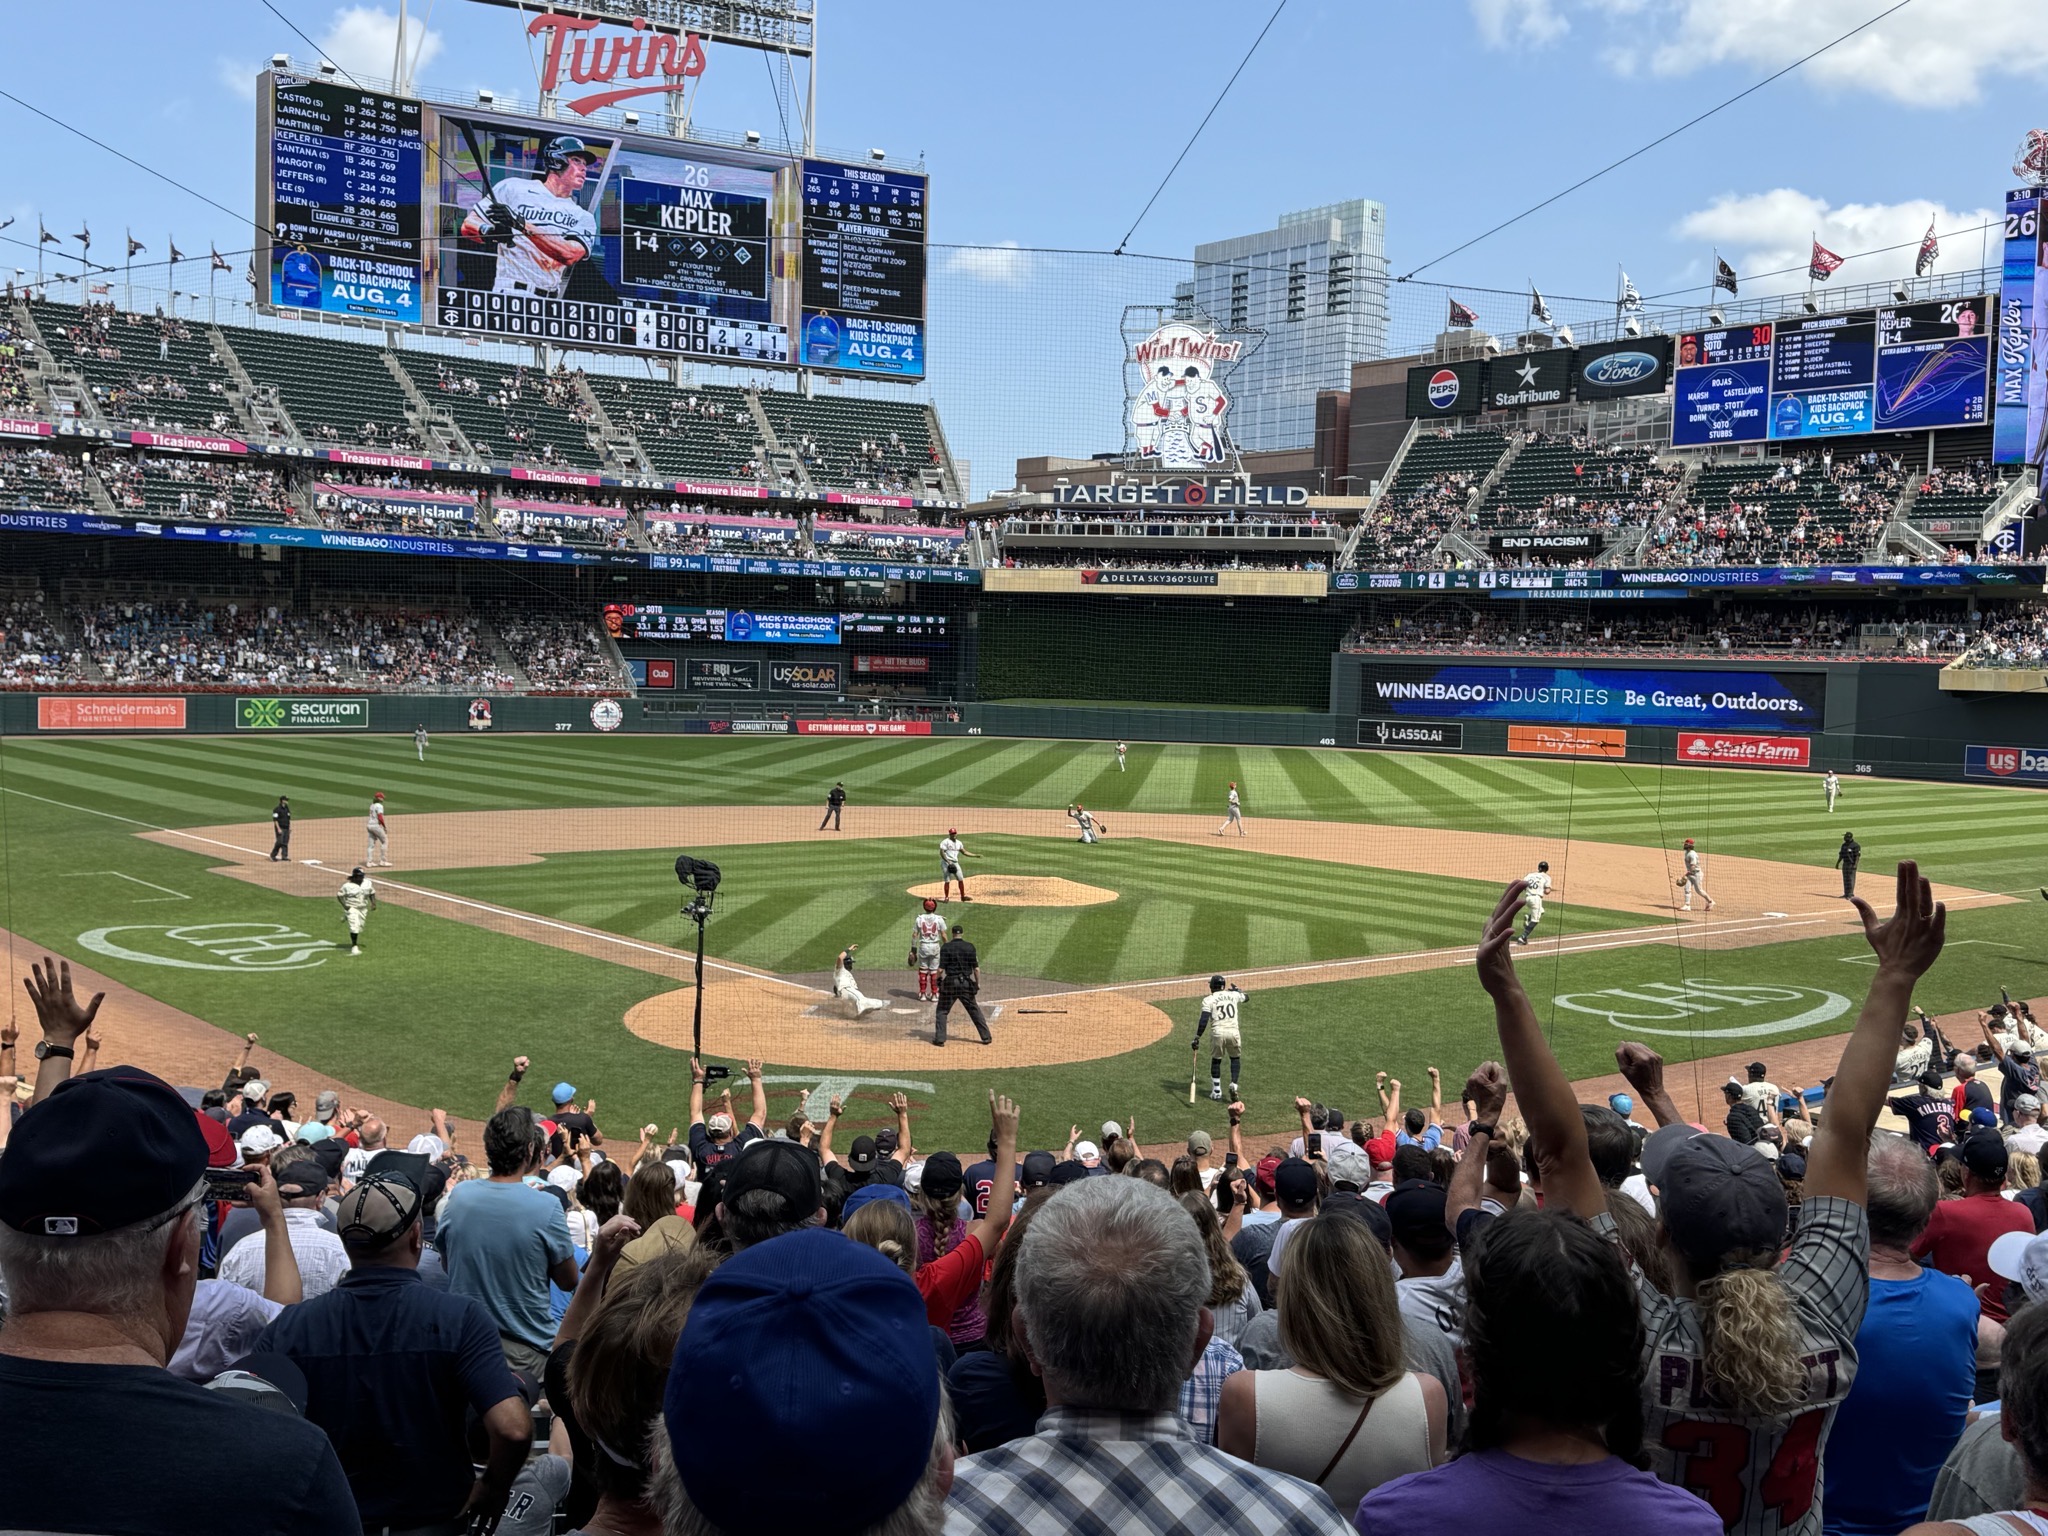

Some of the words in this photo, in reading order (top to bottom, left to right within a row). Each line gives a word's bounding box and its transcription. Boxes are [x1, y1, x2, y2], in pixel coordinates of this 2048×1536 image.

[527, 13, 706, 92] Twins
[277, 92, 312, 105] CASTRO
[277, 105, 318, 119] LARNACH
[277, 118, 310, 130] MARTIN
[278, 131, 310, 142] KEPLER
[277, 144, 317, 157] SANTANA
[277, 156, 313, 169] MARGOT
[277, 169, 314, 182] JEFFERS
[684, 165, 709, 187] 26
[844, 169, 859, 179] THIS
[860, 172, 884, 182] SEASON
[277, 182, 292, 191] LEE
[277, 195, 307, 206] JULIEN
[680, 188, 713, 210] MAX
[2014, 190, 2030, 200] 3:10
[661, 205, 732, 235] KEPLER
[2005, 210, 2036, 238] 26
[838, 223, 861, 234] PLAYER
[863, 226, 889, 237] PROFILE
[634, 231, 659, 252] 1-4
[330, 256, 415, 278] BACK-TO-SCHOOL
[334, 270, 358, 284] KIDS
[359, 274, 410, 291] BACKPACK
[332, 284, 390, 304] AUG.
[396, 294, 412, 307] 4
[472, 295, 481, 307] 0
[492, 297, 500, 309] 0
[512, 299, 520, 311] 0
[531, 301, 539, 313] 0
[552, 304, 557, 316] 1
[569, 306, 577, 318] 2
[589, 308, 594, 320] 1
[607, 310, 614, 322] 0
[625, 311, 632, 324] 0
[643, 314, 650, 325] 4
[661, 316, 668, 328] 9
[679, 318, 686, 330] 0
[697, 320, 704, 332] 8
[1881, 310, 1895, 320] MAX
[846, 318, 917, 335] BACK-TO-SCHOOL
[1881, 317, 1912, 330] KEPLER
[473, 314, 481, 326] 0
[494, 316, 499, 328] 1
[512, 318, 520, 330] 0
[532, 320, 539, 332] 0
[551, 323, 558, 334] 0
[570, 325, 577, 337] 0
[588, 327, 596, 339] 3
[607, 329, 614, 340] 0
[643, 333, 650, 344] 4
[661, 335, 668, 347] 8
[679, 337, 686, 348] 0
[697, 338, 704, 350] 9
[850, 330, 869, 342] KIDS
[871, 332, 913, 346] BACKPACK
[1704, 332, 1727, 341] GREGORY
[1752, 326, 1770, 345] 30
[2002, 299, 2030, 364] Kepler
[719, 330, 726, 343] 2
[745, 333, 752, 346] 2
[771, 336, 776, 348] 1
[1704, 340, 1722, 351] SOTO
[848, 343, 896, 359] AUG.
[901, 349, 914, 361] 4
[1134, 337, 1176, 363] Win!
[1178, 333, 1240, 362] Twins!
[1598, 354, 1643, 380] Ford
[1430, 384, 1457, 394] PEPSI
[1712, 378, 1732, 387] ROJAS
[2004, 368, 2022, 403] MAX
[1688, 392, 1709, 400] MARSH
[1723, 386, 1764, 397] CASTELLANOS
[1808, 390, 1868, 404] BACK-TO-SCHOOL
[1196, 396, 1208, 413] S
[1696, 403, 1720, 412] TURNER
[1724, 401, 1744, 410] STOTT
[1810, 403, 1826, 413] KIDS
[1828, 401, 1864, 412] BACKPACK
[1690, 414, 1707, 422] BOHM
[1733, 409, 1758, 418] HARPER
[1808, 412, 1849, 425] AUG.
[1853, 411, 1865, 421] 4
[1709, 430, 1733, 438] STUBBS
[340, 452, 388, 466] Treasure
[391, 456, 422, 469] Island
[686, 484, 727, 496] Treasure
[730, 487, 759, 498] Island
[1054, 484, 1180, 506] TARGET
[1214, 486, 1308, 505] FIELD
[1502, 538, 1532, 547] END
[1533, 537, 1588, 546] RACISM
[1528, 590, 1574, 598] TREASURE
[1579, 590, 1614, 598] ISLAND
[1620, 590, 1644, 598] COVE
[755, 615, 836, 624] BACK-TO-SCHOOL
[759, 622, 781, 630] KIDS
[782, 623, 832, 631] BACKPACK
[908, 658, 926, 666] BUDS
[653, 670, 669, 678] Cub
[714, 664, 730, 675] RBI
[1624, 690, 1646, 706] Be
[1651, 690, 1707, 713] Great,
[1712, 692, 1803, 712] Outdoors.
[76, 703, 177, 715] Schneiderman's
[291, 703, 360, 715] securian
[732, 723, 770, 731] COMMUNITY
[772, 723, 788, 731] FUND
[968, 727, 982, 735] 411
[1319, 738, 1335, 746] 403
[1392, 728, 1442, 742] LASSO.AI
[1536, 733, 1595, 752] Paycor
[1855, 764, 1872, 773] 365
[1990, 754, 2015, 770] us
[1216, 1004, 1235, 1020] 30
[1663, 1411, 1826, 1531] 34
